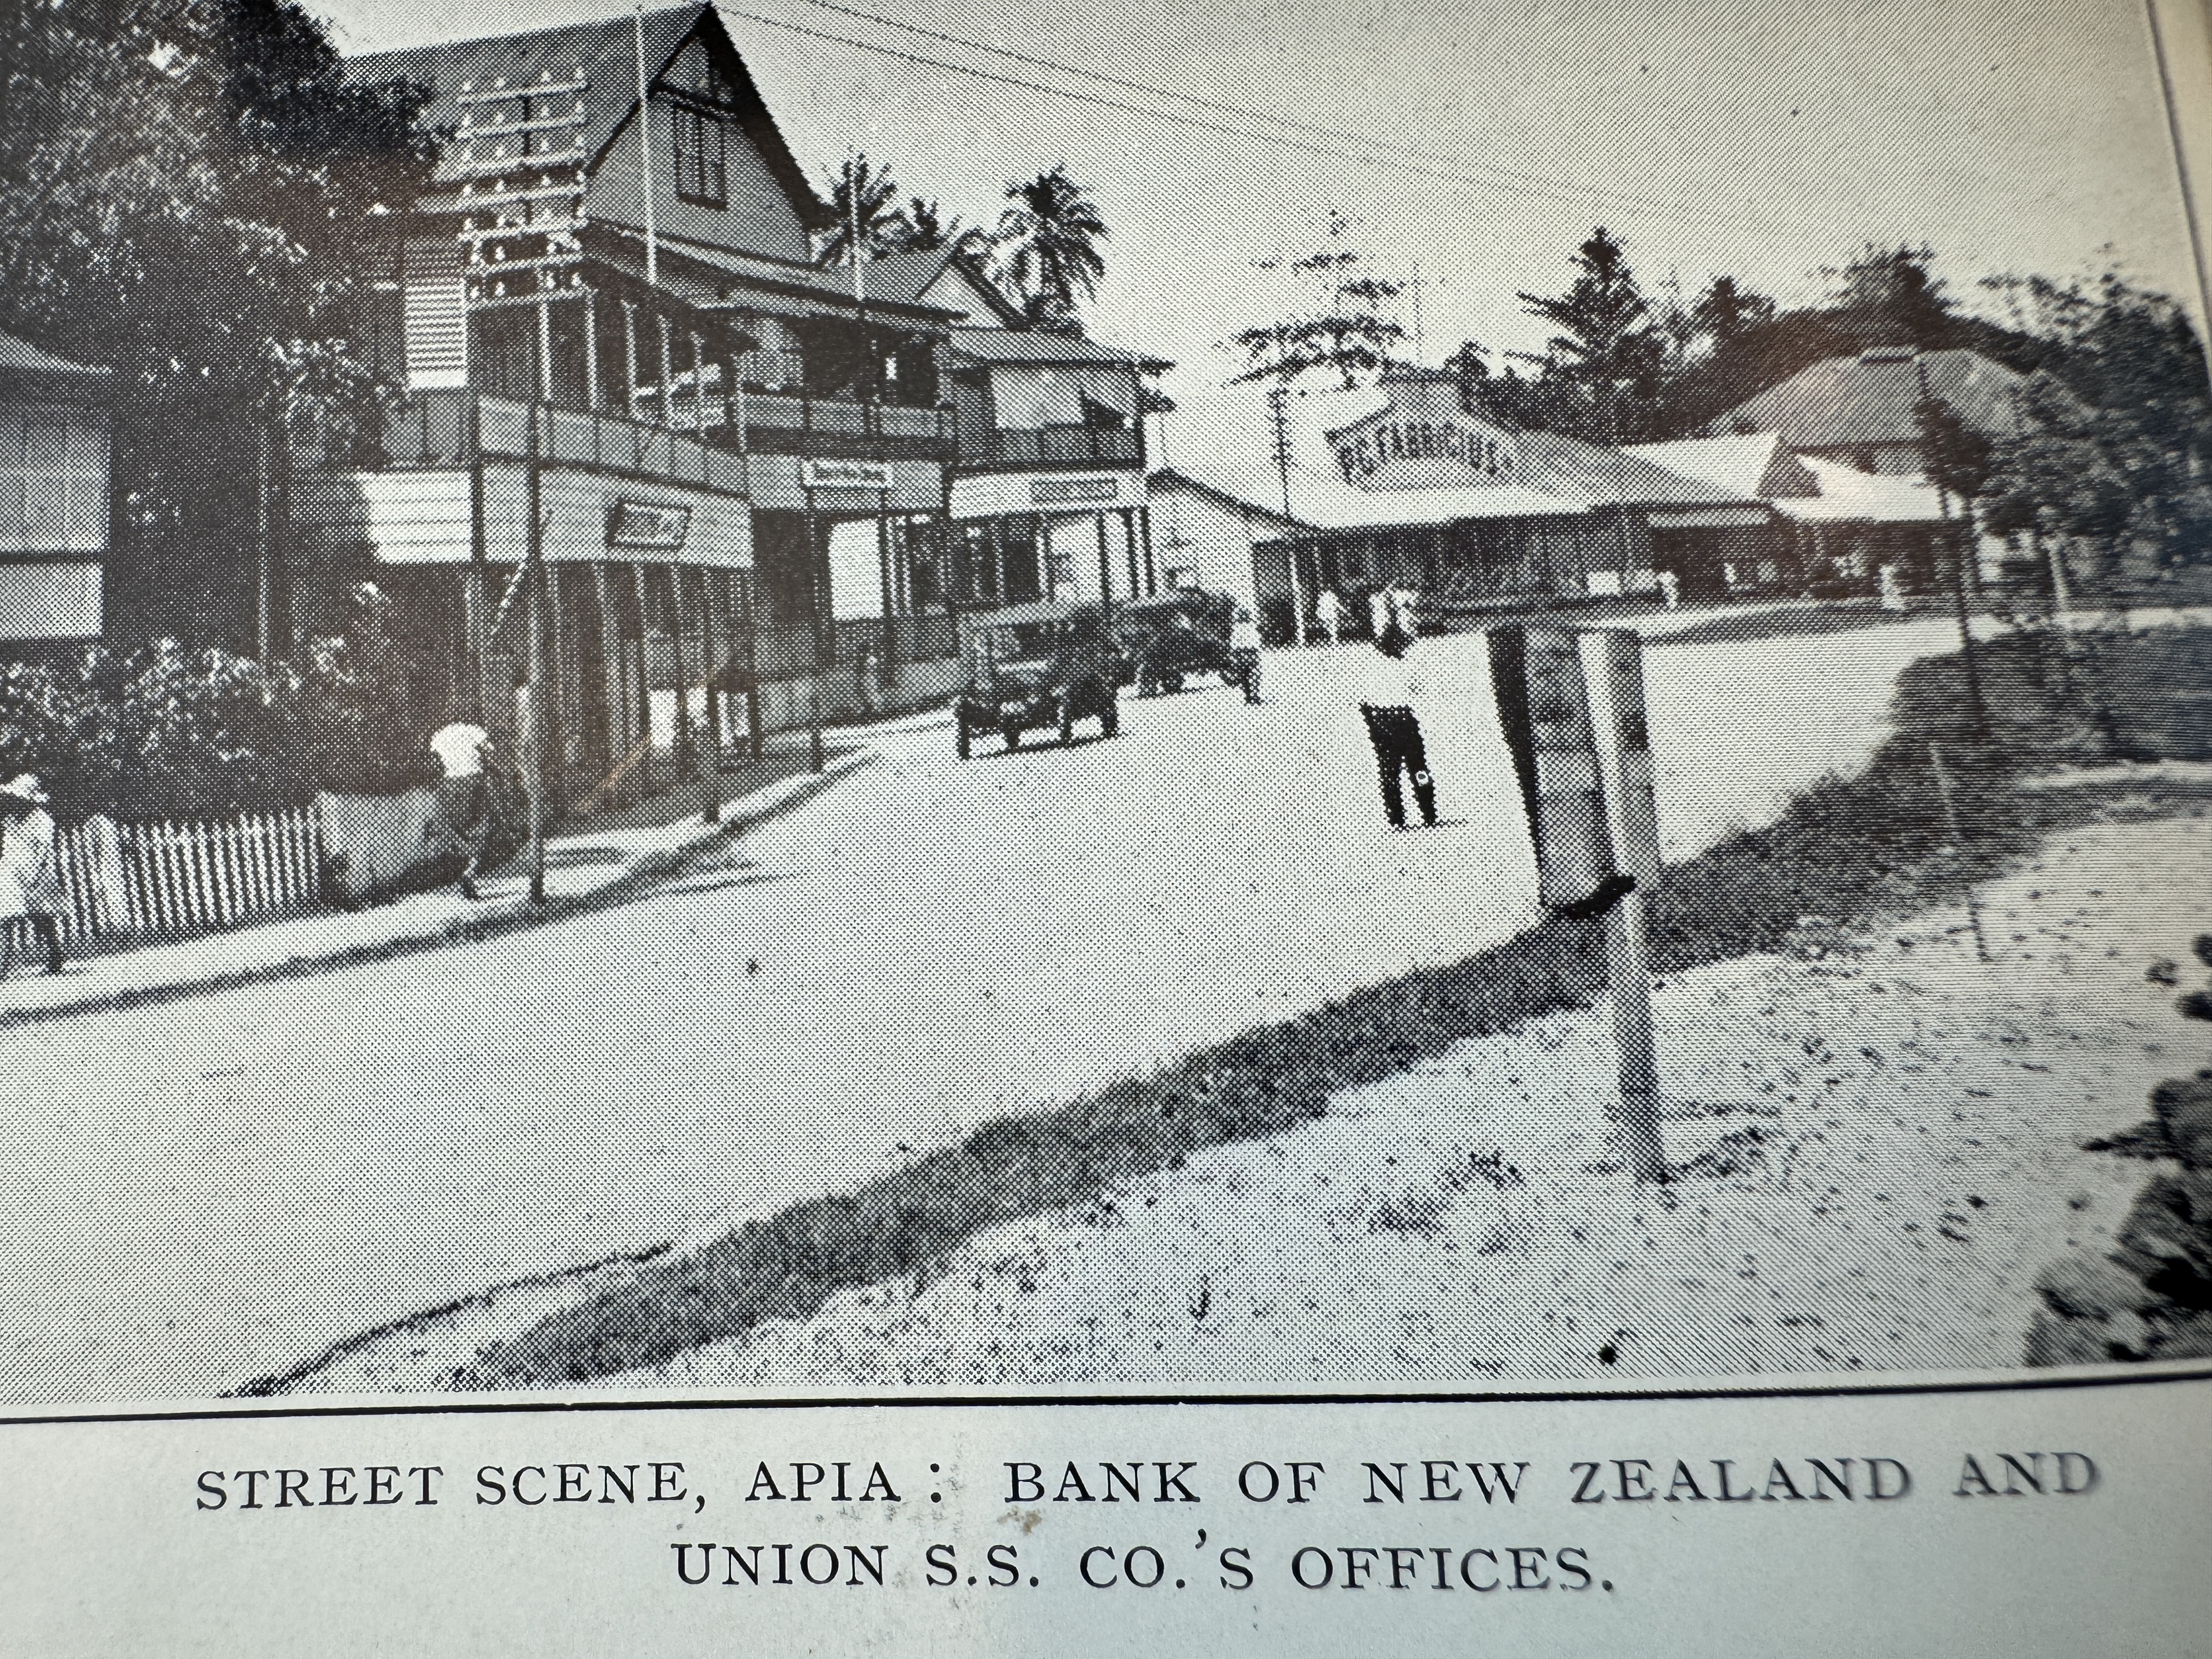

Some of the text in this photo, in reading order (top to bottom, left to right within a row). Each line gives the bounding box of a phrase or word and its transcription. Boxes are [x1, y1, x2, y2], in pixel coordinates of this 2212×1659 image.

[197, 1466, 443, 1511] STREET
[476, 1463, 705, 1514] SCENE,
[745, 1461, 901, 1502] APIA
[1003, 1461, 1200, 1504] BANK
[1239, 1461, 1325, 1504] OF
[1361, 1461, 1531, 1504] NEW
[1570, 1457, 1912, 1504] ZEALAND
[1953, 1452, 2100, 1498] AND
[670, 1528, 1614, 1593] UNION S.S. CO.'S OFFICES.
